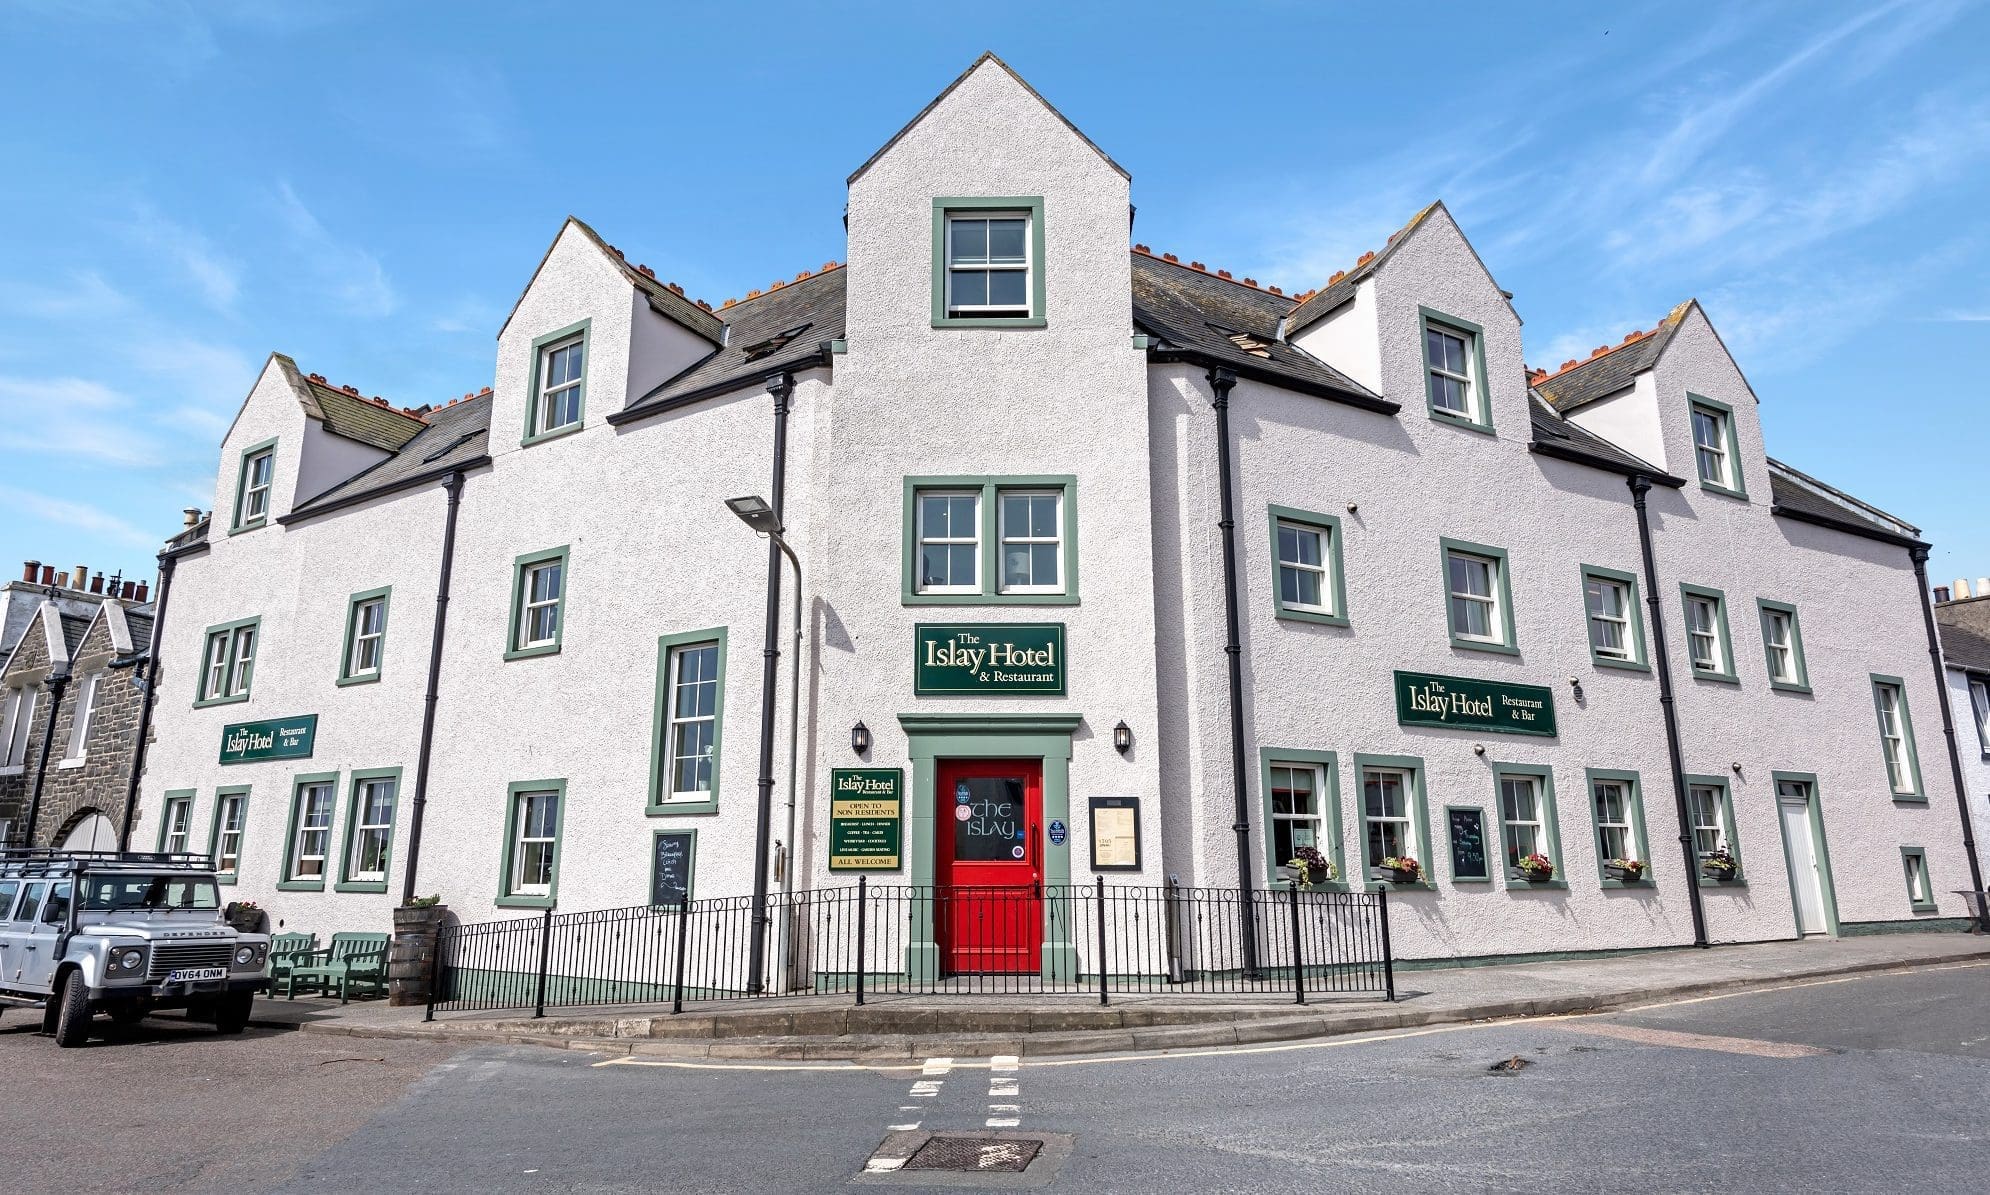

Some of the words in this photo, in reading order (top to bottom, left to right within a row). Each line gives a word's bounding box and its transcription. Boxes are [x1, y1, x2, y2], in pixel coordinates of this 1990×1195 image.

[958, 633, 980, 644] The
[925, 639, 986, 676] Islay
[988, 642, 1056, 667] Hotel
[980, 672, 990, 682] &
[994, 671, 1054, 682] Restaurant
[1430, 681, 1446, 693] The
[1408, 685, 1449, 720] Islay
[1450, 692, 1494, 718] Hotel
[1502, 694, 1543, 709] Restaurant
[1511, 710, 1519, 720] &
[1521, 710, 1536, 721] Bar
[240, 728, 248, 736] The
[226, 732, 249, 757] Islay
[248, 731, 274, 750] Hotel
[280, 727, 307, 736] Restaurant
[283, 738, 289, 747] &
[290, 737, 299, 746] Bar
[838, 778, 864, 794] Islay
[866, 778, 894, 790] Hotel
[203, 969, 223, 979] ONM
